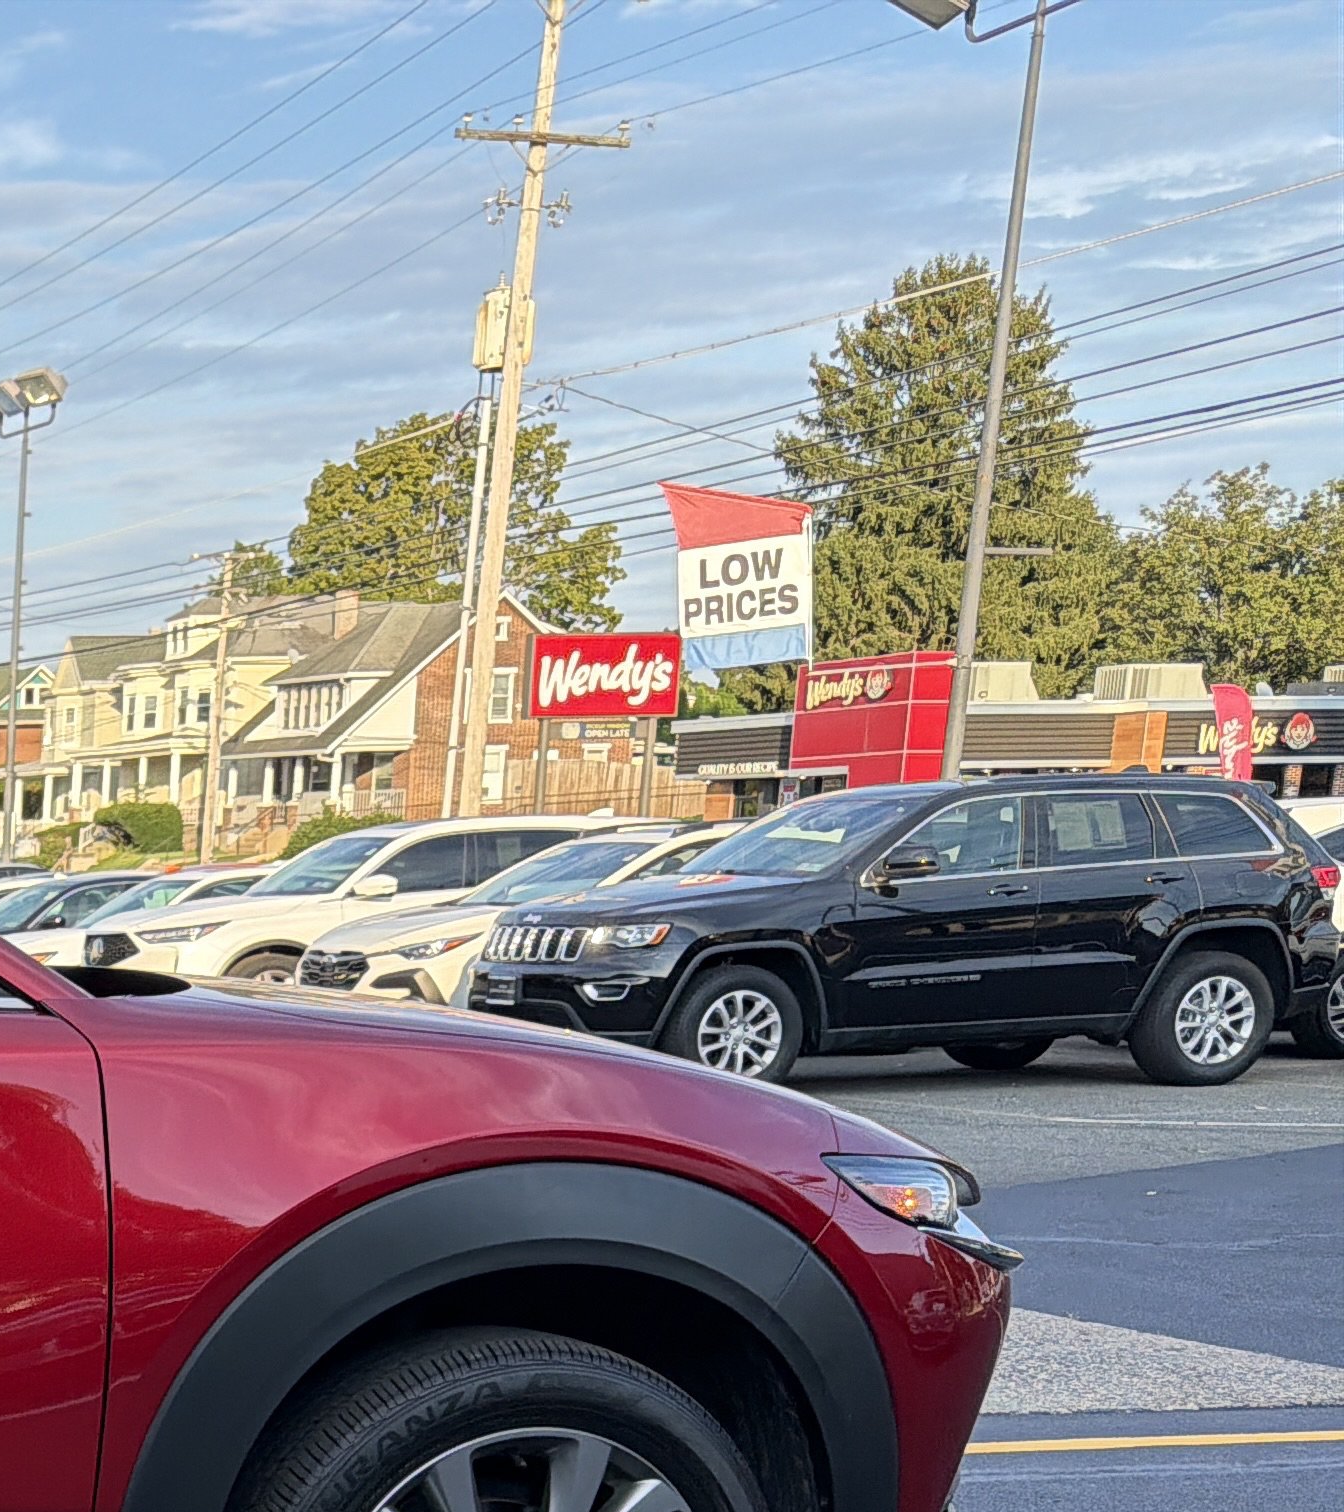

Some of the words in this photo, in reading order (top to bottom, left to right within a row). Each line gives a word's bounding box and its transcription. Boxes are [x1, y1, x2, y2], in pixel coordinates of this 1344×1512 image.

[699, 547, 784, 590] LOW
[683, 583, 800, 628] PRICES
[538, 643, 674, 708] Wendy's
[805, 671, 864, 710] Wendy's
[584, 729, 609, 738] OPEN
[610, 728, 630, 738] LATE
